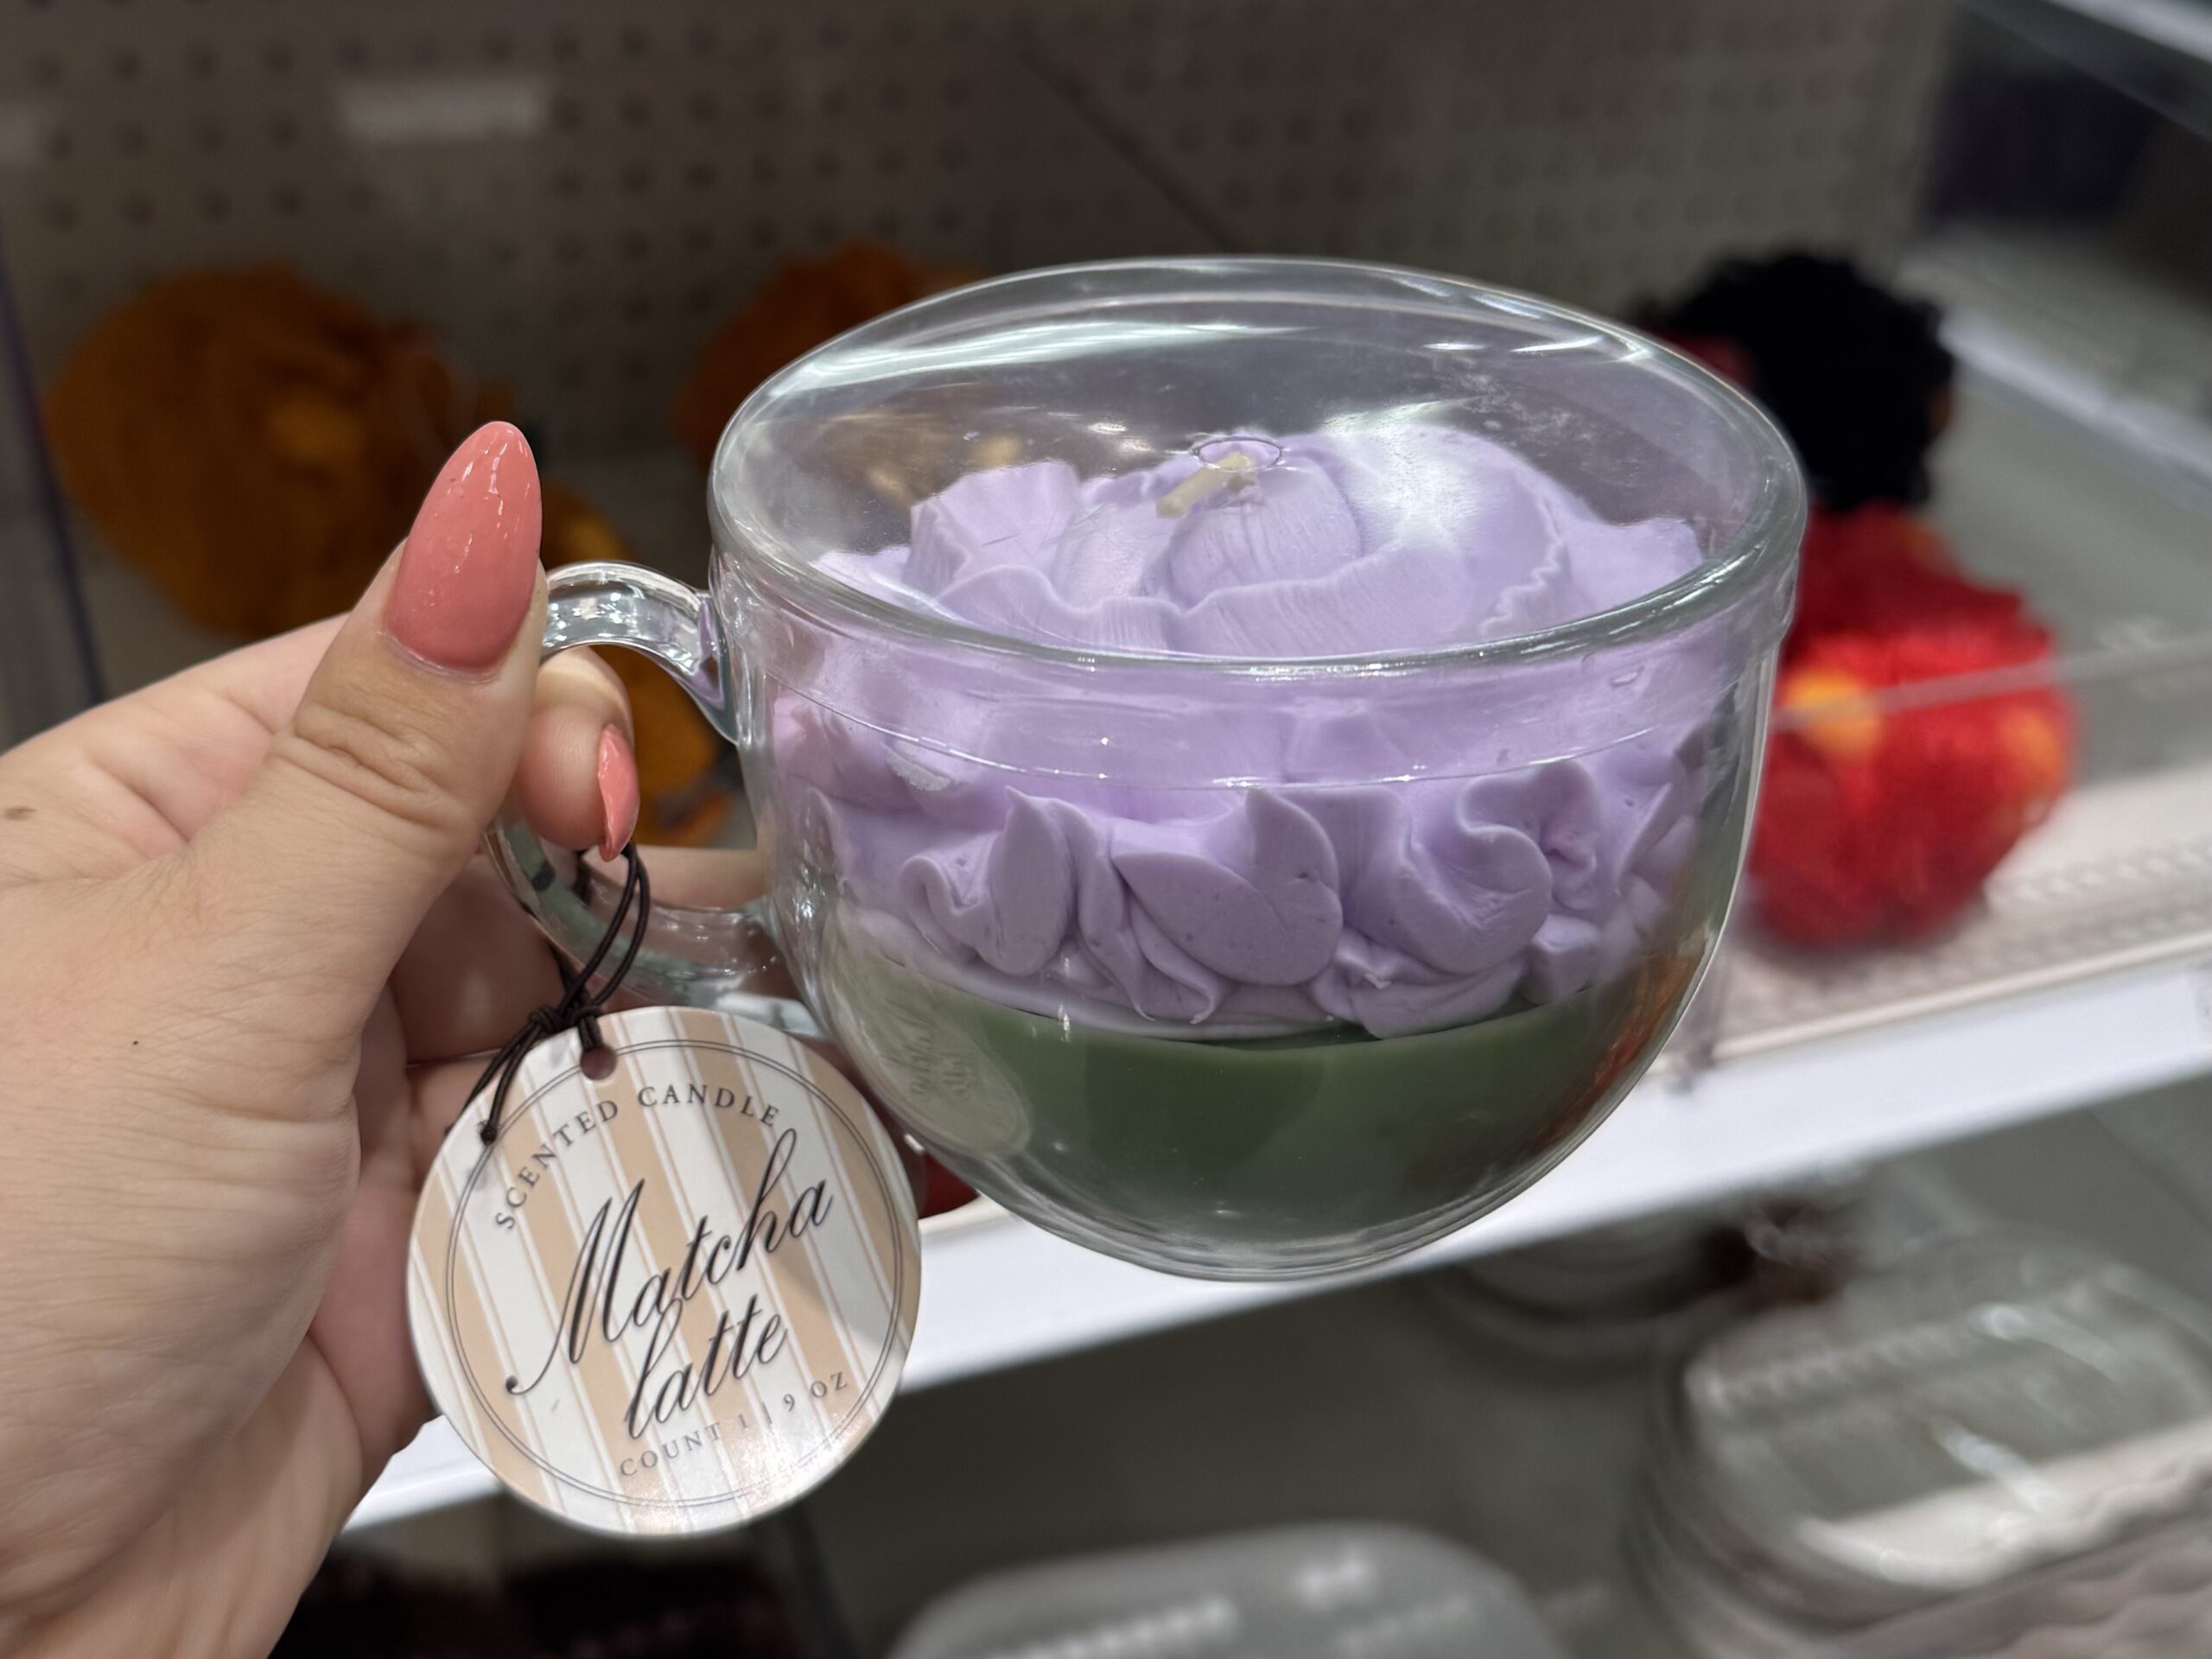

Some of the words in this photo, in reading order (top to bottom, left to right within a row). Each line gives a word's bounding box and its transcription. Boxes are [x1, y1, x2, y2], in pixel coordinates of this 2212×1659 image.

[495, 1100, 619, 1230] SCENTED
[638, 1084, 779, 1127] CANDLE
[505, 1128, 834, 1395] Matcha
[619, 1422, 722, 1478] COUNT
[783, 1393, 796, 1413] 9
[810, 1370, 849, 1399] OZ
[623, 1294, 789, 1440] latte
